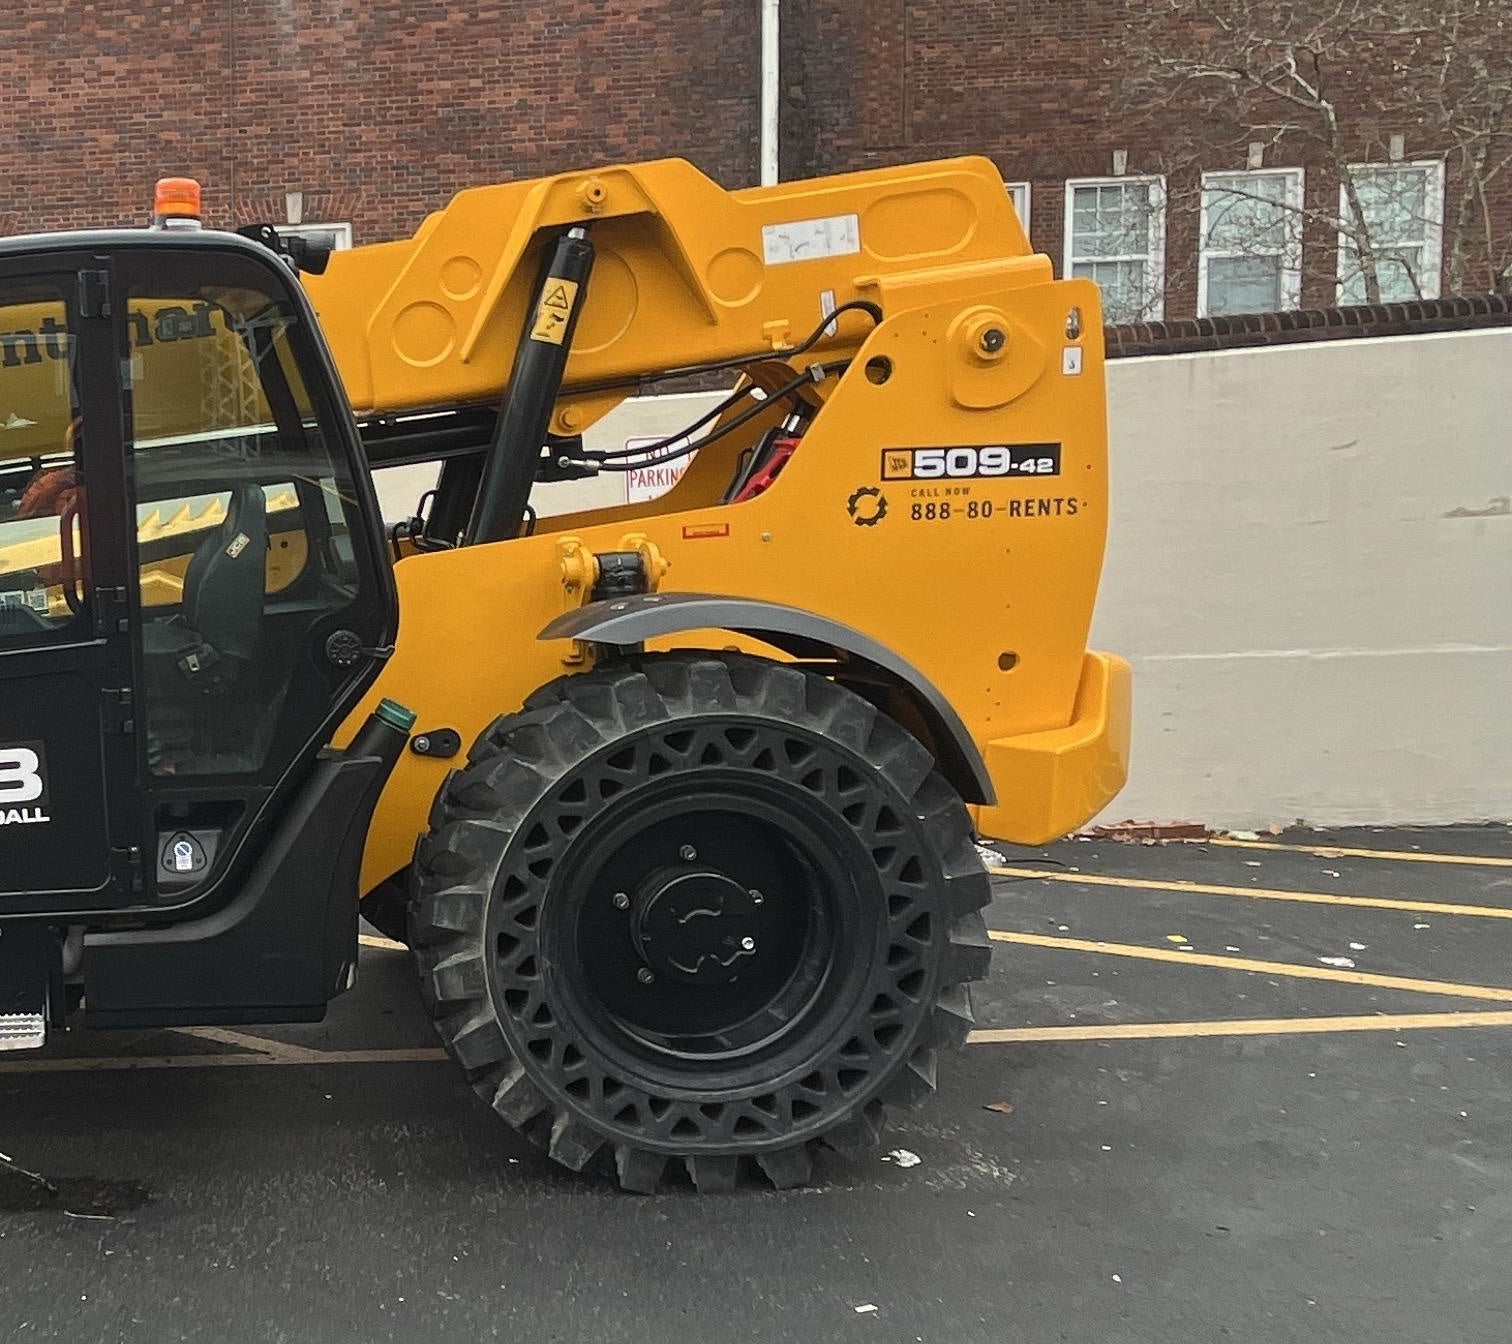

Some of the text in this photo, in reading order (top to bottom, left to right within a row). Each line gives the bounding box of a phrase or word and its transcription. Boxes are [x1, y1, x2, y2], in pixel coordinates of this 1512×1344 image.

[913, 446, 1055, 478] 509-42
[629, 467, 685, 488] PARKIN
[910, 486, 971, 498] CALL NOW
[910, 498, 1079, 521] 888-80-RENTS
